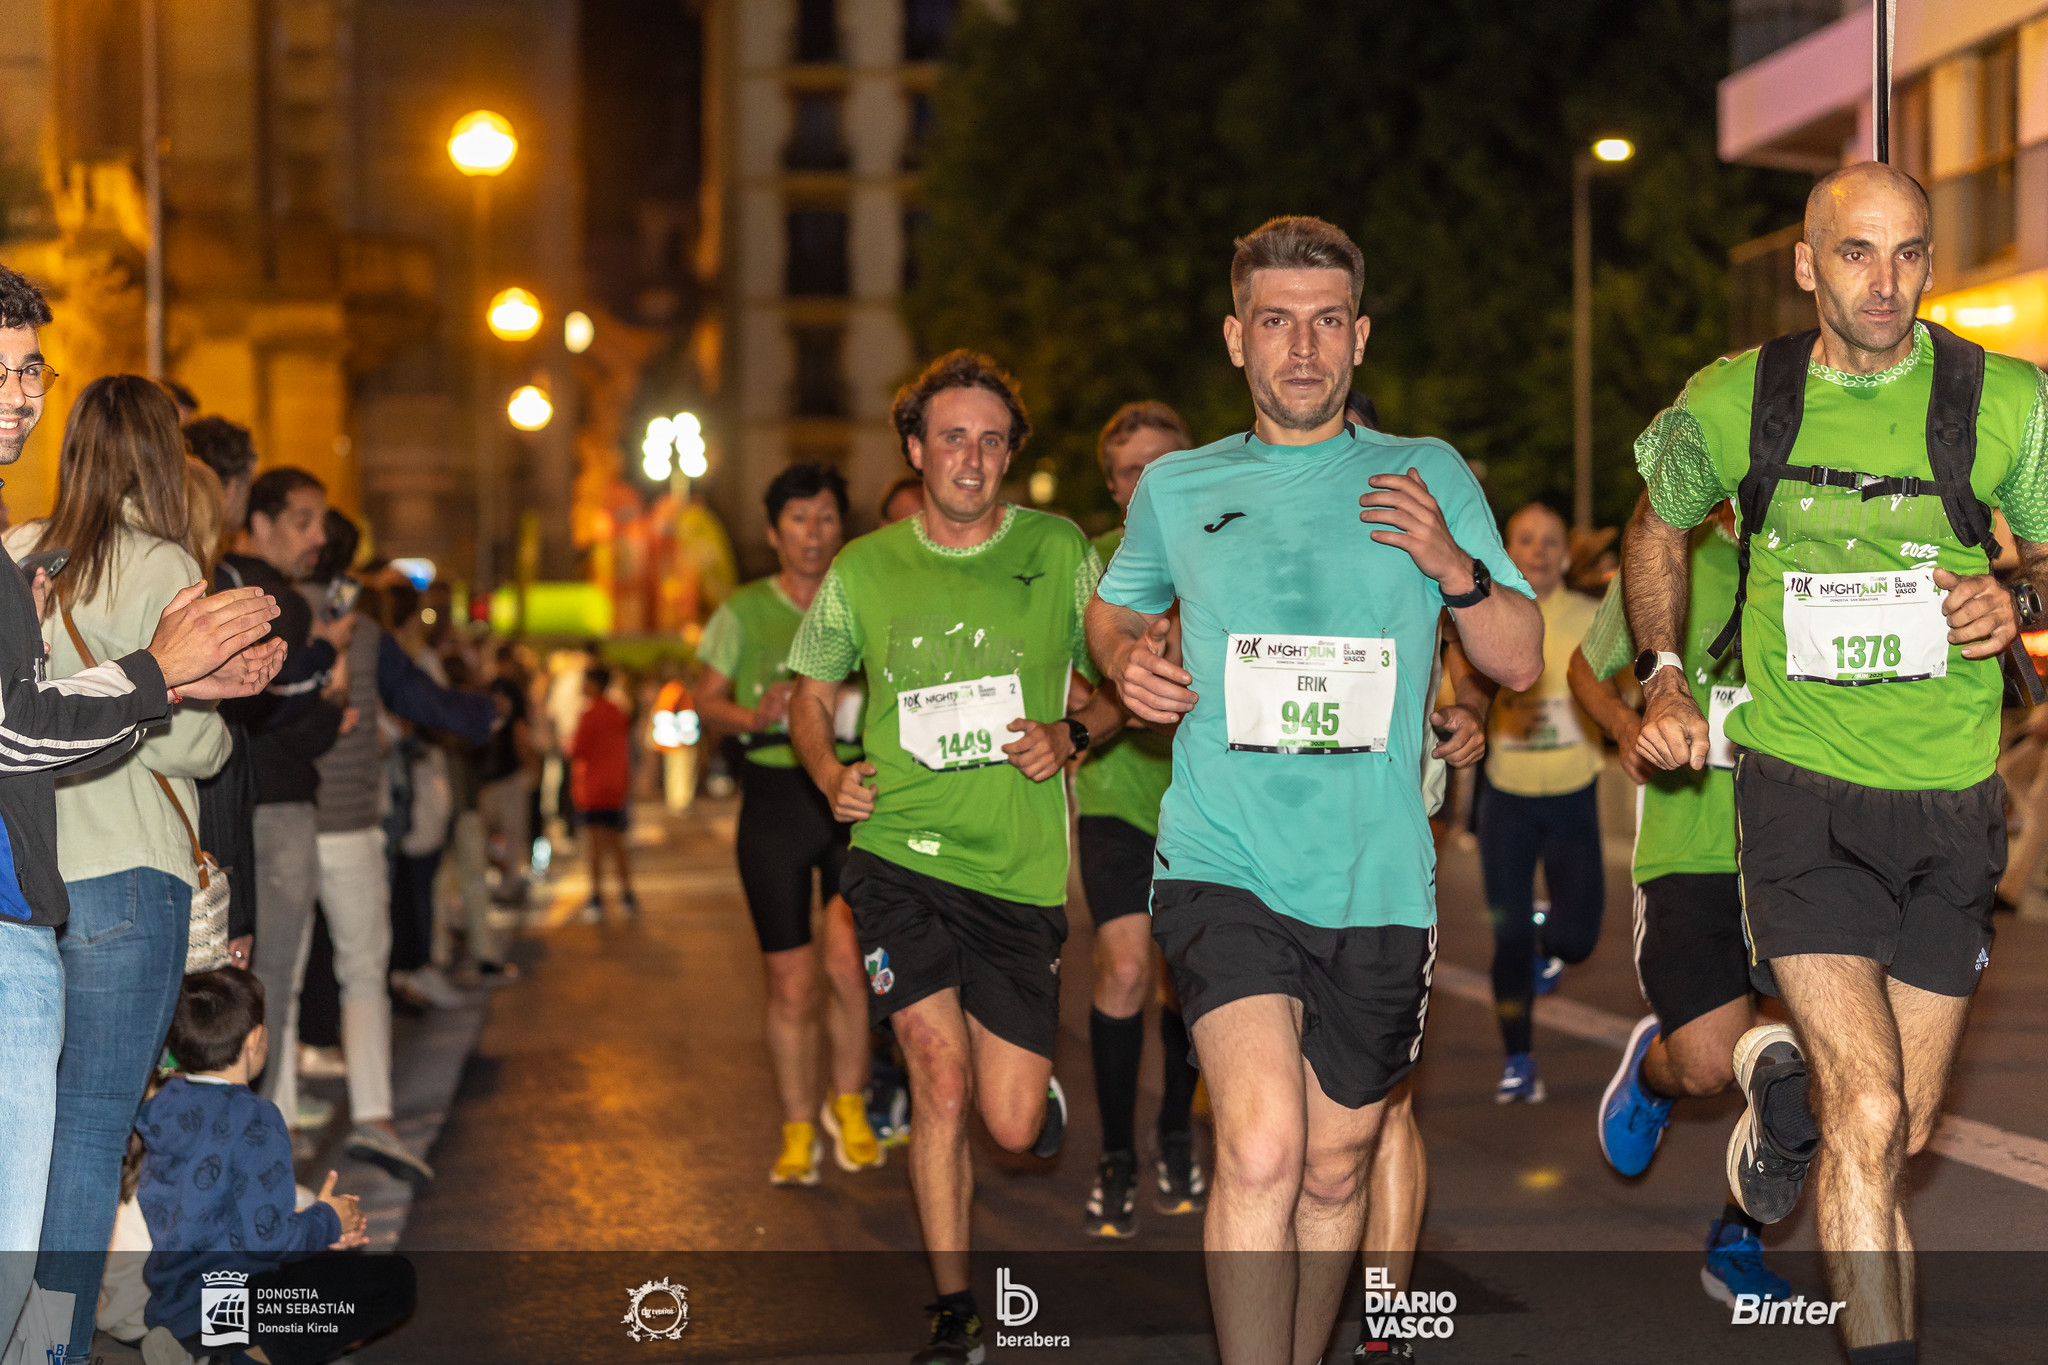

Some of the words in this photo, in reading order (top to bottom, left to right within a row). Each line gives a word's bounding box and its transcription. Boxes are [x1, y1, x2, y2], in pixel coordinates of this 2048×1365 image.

[1900, 541, 1940, 560] 2025
[1790, 577, 1813, 598] 10K
[1235, 637, 1262, 658] 10K
[1832, 634, 1902, 669] 1378
[1381, 650, 1390, 667] 3
[1009, 682, 1016, 694] 2
[1297, 675, 1328, 692] ERIK
[903, 692, 922, 708] 10K
[1715, 690, 1736, 704] 10K
[1281, 700, 1340, 736] 945
[937, 728, 992, 759] 1449
